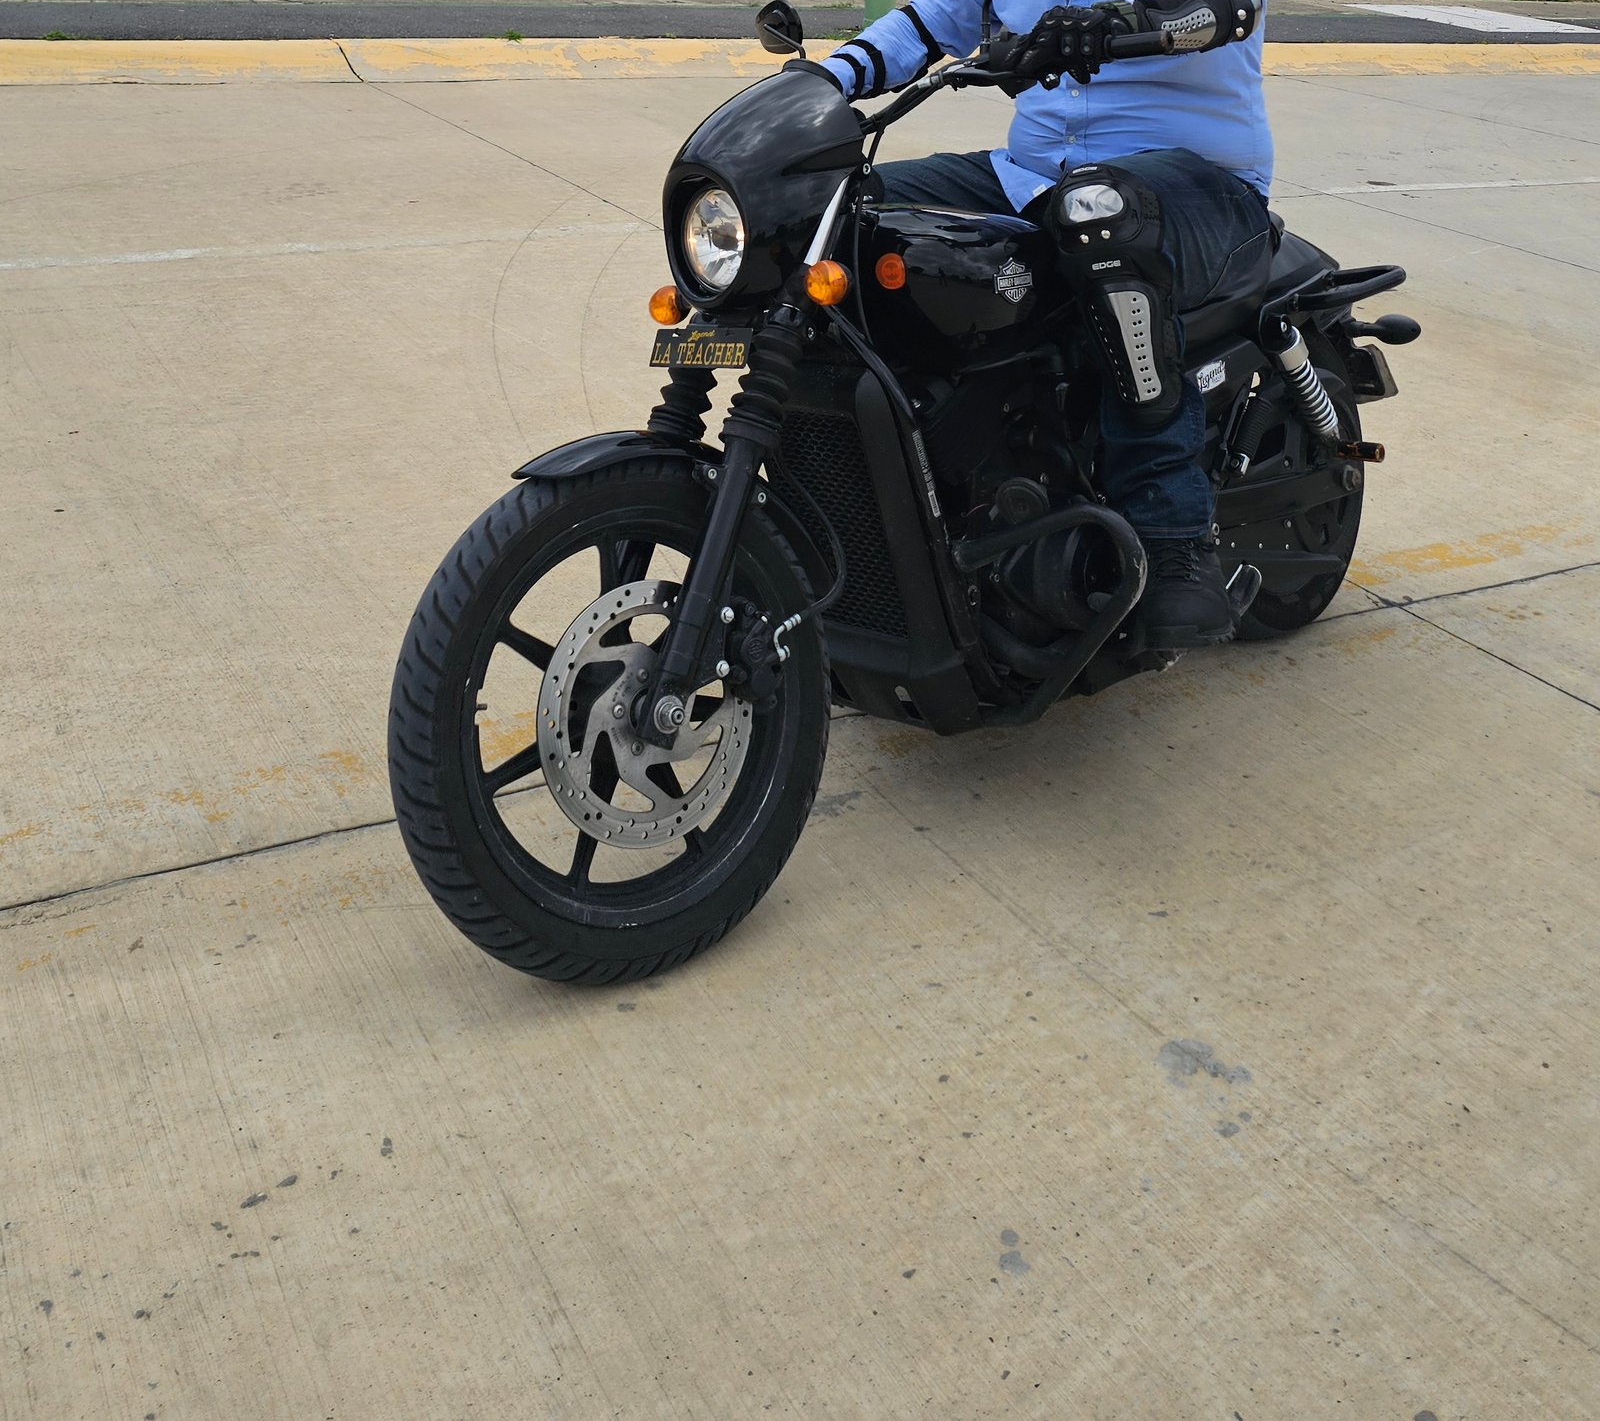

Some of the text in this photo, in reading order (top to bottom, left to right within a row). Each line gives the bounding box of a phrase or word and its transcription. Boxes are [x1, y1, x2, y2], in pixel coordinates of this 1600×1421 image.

[1092, 260, 1121, 271] EDGE
[652, 343, 745, 365] LA TEACHER
